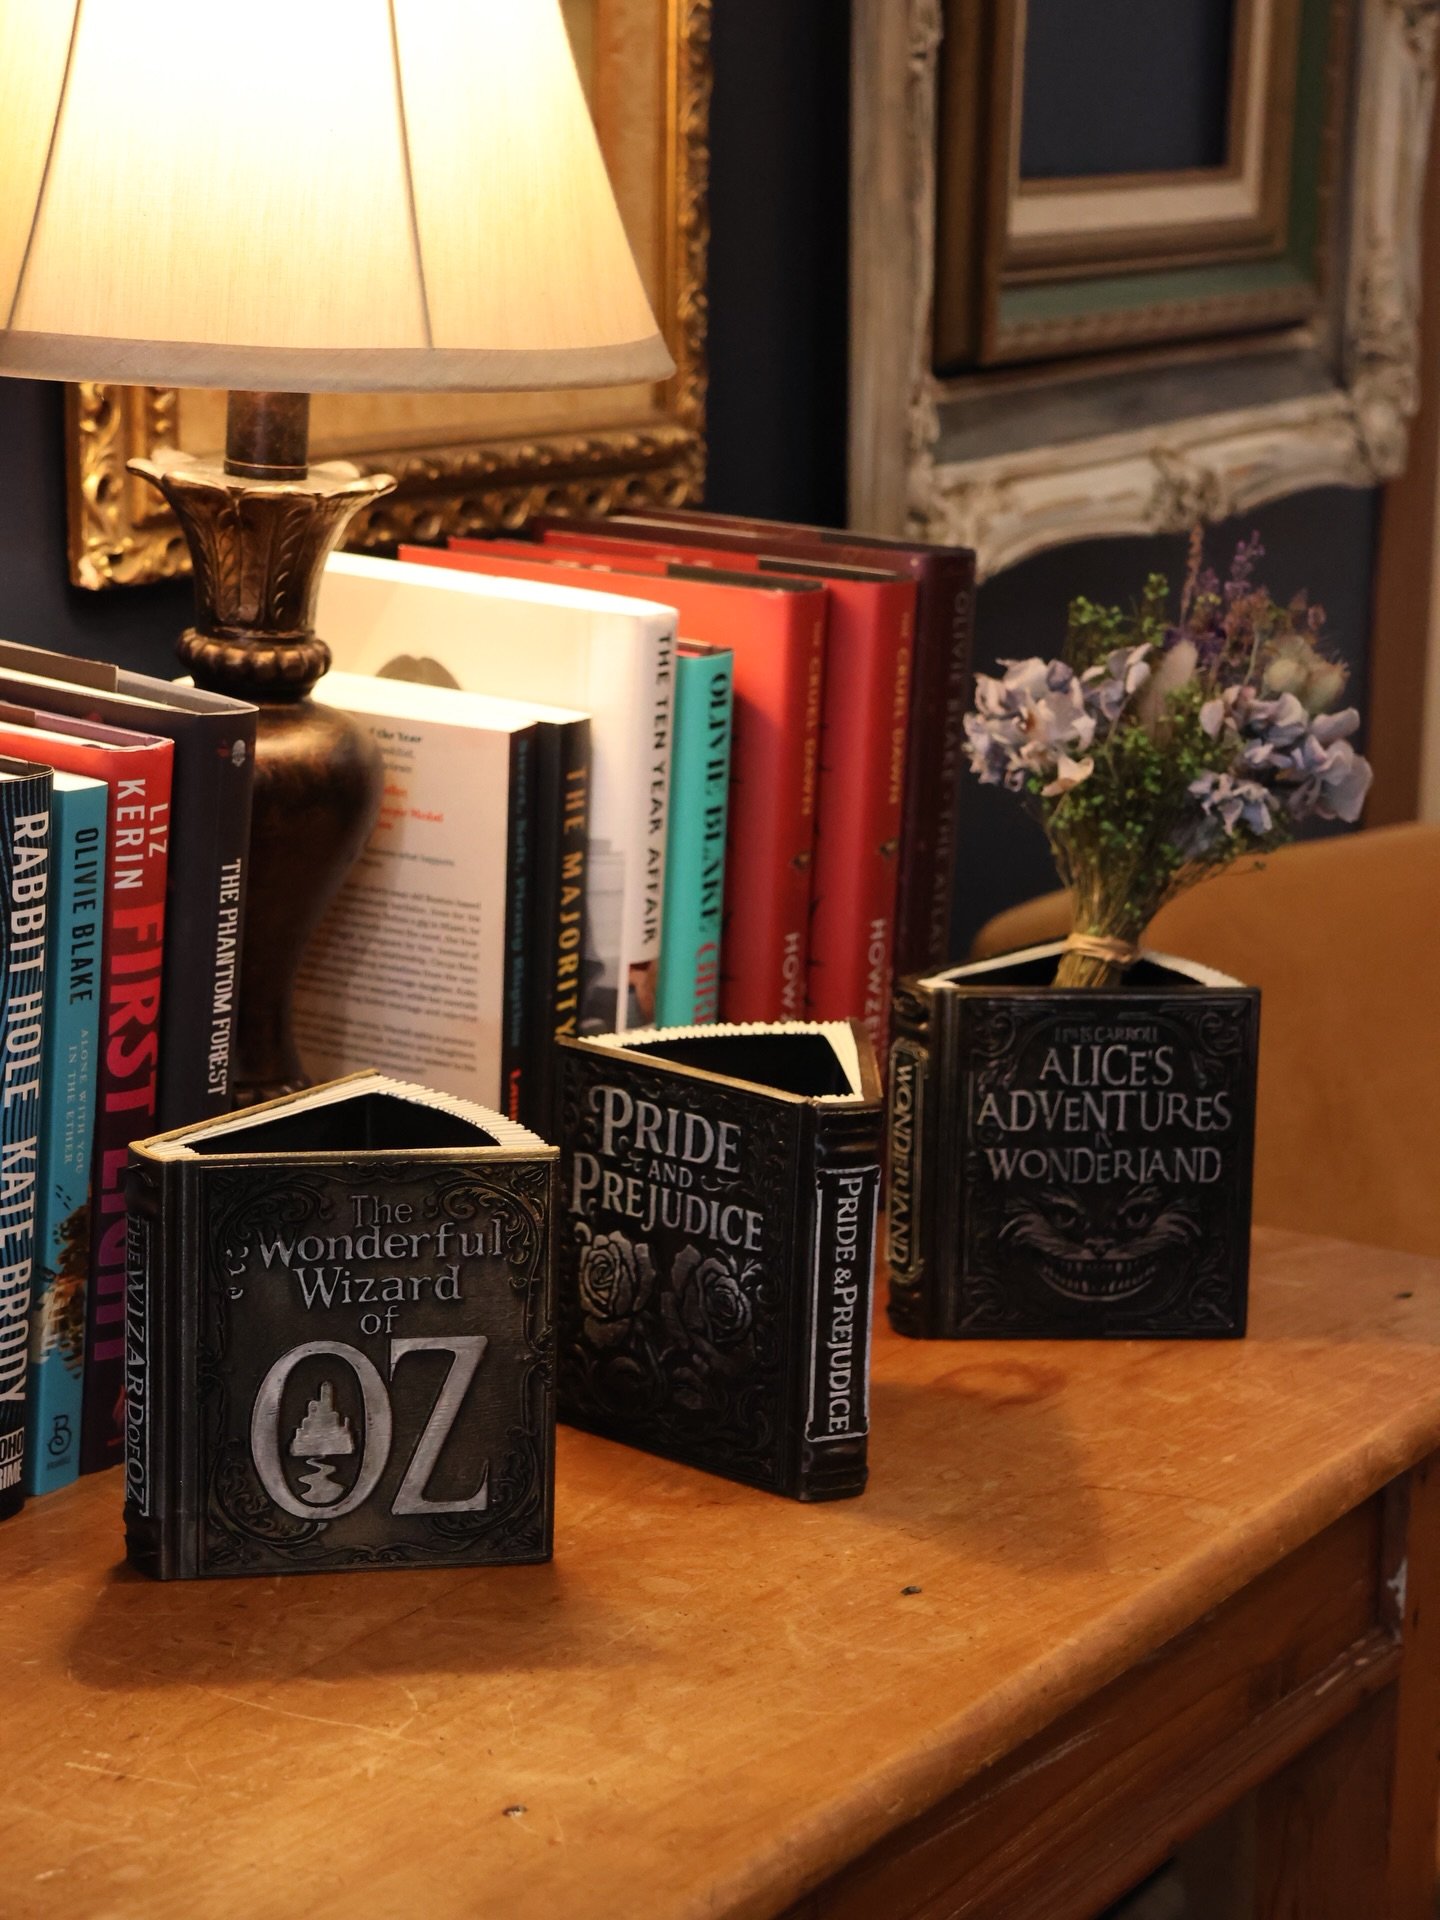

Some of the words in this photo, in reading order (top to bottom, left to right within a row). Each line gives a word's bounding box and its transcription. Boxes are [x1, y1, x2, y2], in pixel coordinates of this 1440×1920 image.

[656, 632, 672, 685] THE
[653, 696, 669, 749] TEN
[563, 768, 588, 835] THE
[649, 760, 666, 835] YEAR
[113, 778, 147, 889] KERIN
[148, 803, 169, 858] LIZ
[9, 811, 49, 973] RABBIT
[73, 827, 100, 914] OLIVIE
[219, 858, 242, 904] THE
[642, 847, 661, 945] AFFAIR
[69, 922, 96, 1007] BLAKE
[212, 907, 239, 1014] PHANTOM
[554, 851, 584, 1040] MAJORITY
[105, 902, 164, 1116] FIRST
[3, 990, 43, 1109] HOLE
[67, 1046, 78, 1065] IN
[79, 1028, 89, 1083] ALONE
[207, 1016, 232, 1096] FOREST
[1039, 1044, 1174, 1086] ALICE'S
[66, 1072, 77, 1105] THE
[77, 1090, 88, 1135] WITH
[977, 1089, 1233, 1132] ADVENTURES
[63, 1110, 76, 1165] ETHER
[588, 1085, 742, 1174] PRIDE
[75, 1140, 87, 1175] YOU
[647, 1159, 693, 1188] AND
[888, 1063, 914, 1266] WONDERLAND
[986, 1146, 1222, 1184] WONDERLAND
[0, 1135, 37, 1249] KATE
[351, 1195, 412, 1226] The
[568, 1152, 764, 1253] PREJUDICE
[831, 1175, 865, 1264] PRIDE
[257, 1218, 503, 1268] Wonderful
[292, 1266, 462, 1309] Wizard
[835, 1266, 855, 1284] &
[0, 1258, 32, 1401] BRODY
[359, 1307, 400, 1335] of
[828, 1283, 858, 1434] PREJUDICE
[0, 1429, 24, 1464] OHO
[250, 1335, 489, 1521] OZ
[0, 1458, 22, 1491] RIME
